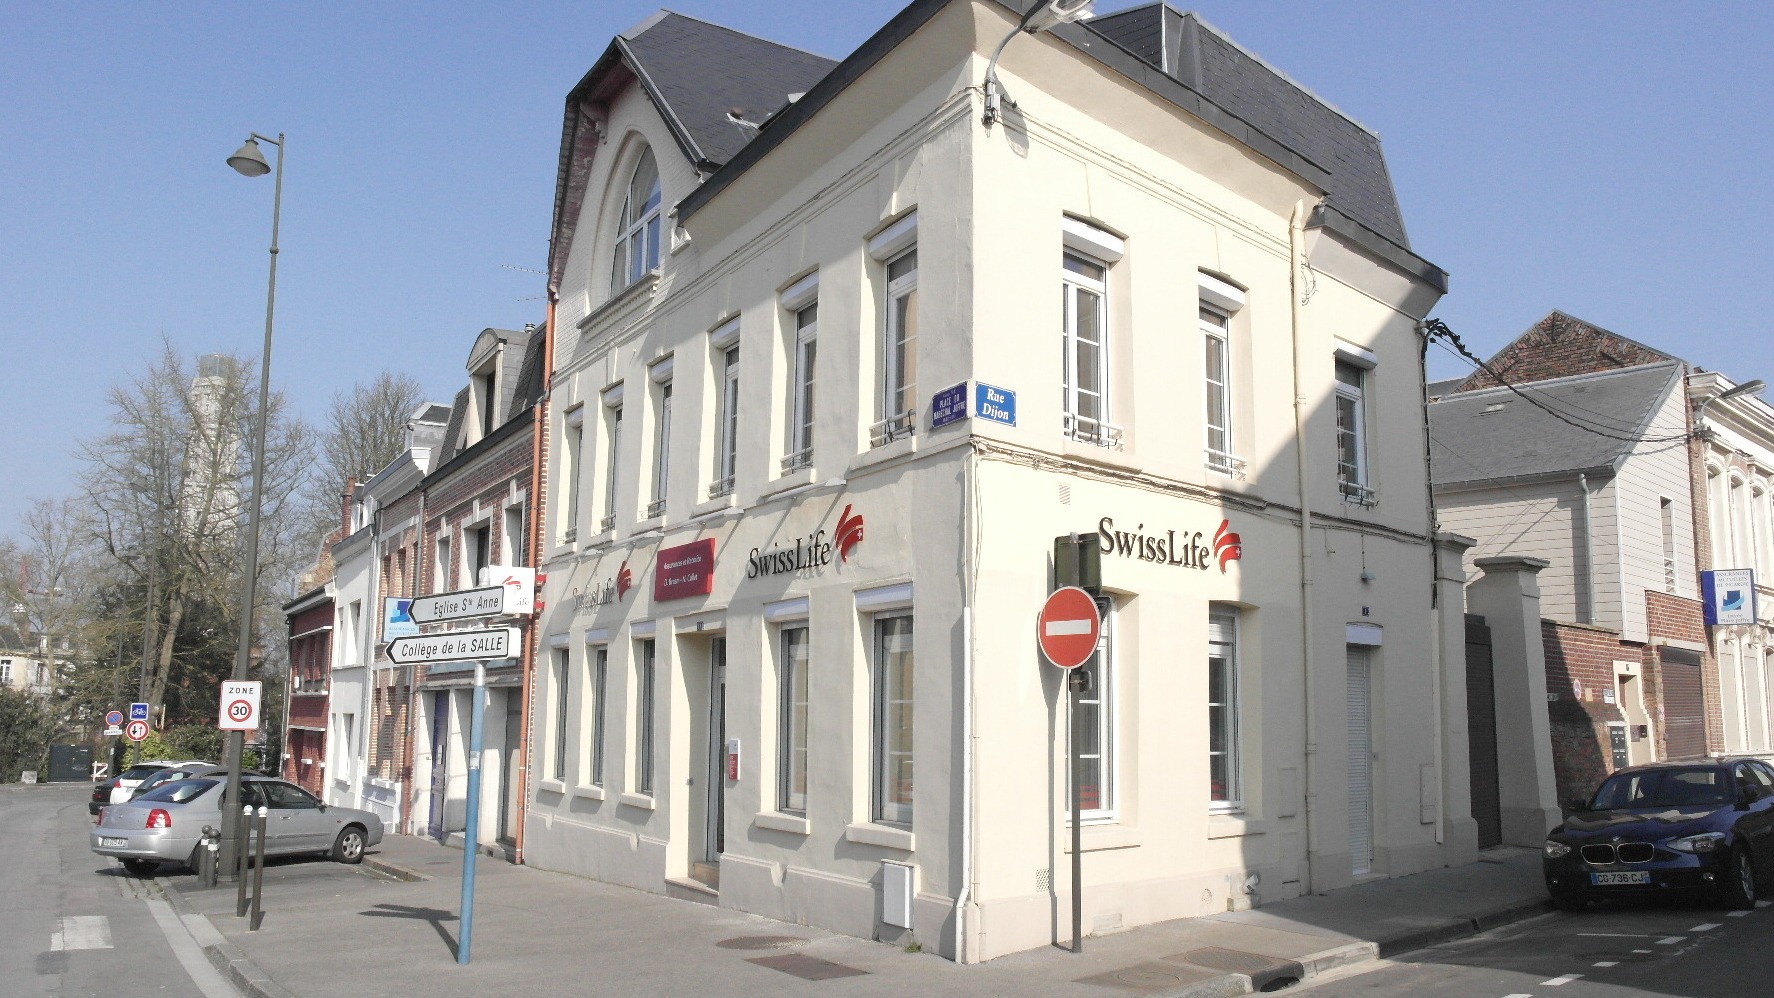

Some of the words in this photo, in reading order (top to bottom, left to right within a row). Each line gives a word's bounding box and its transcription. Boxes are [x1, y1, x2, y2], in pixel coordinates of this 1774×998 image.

[940, 397, 951, 408] PLACE
[987, 388, 1005, 404] Rue
[953, 401, 965, 412] JOFFRE
[982, 402, 1009, 420] Dijon
[1098, 516, 1210, 571] SwissLife
[747, 529, 831, 579] SwissLife
[433, 601, 458, 618] Eglise
[476, 596, 499, 610] Anne
[401, 642, 438, 659] Collège
[441, 640, 454, 655] de
[457, 640, 467, 654] la
[470, 636, 503, 653] SALLE
[228, 687, 254, 695] ZONE
[232, 705, 248, 716] 30
[1597, 873, 1644, 883] CG-736-CJ
